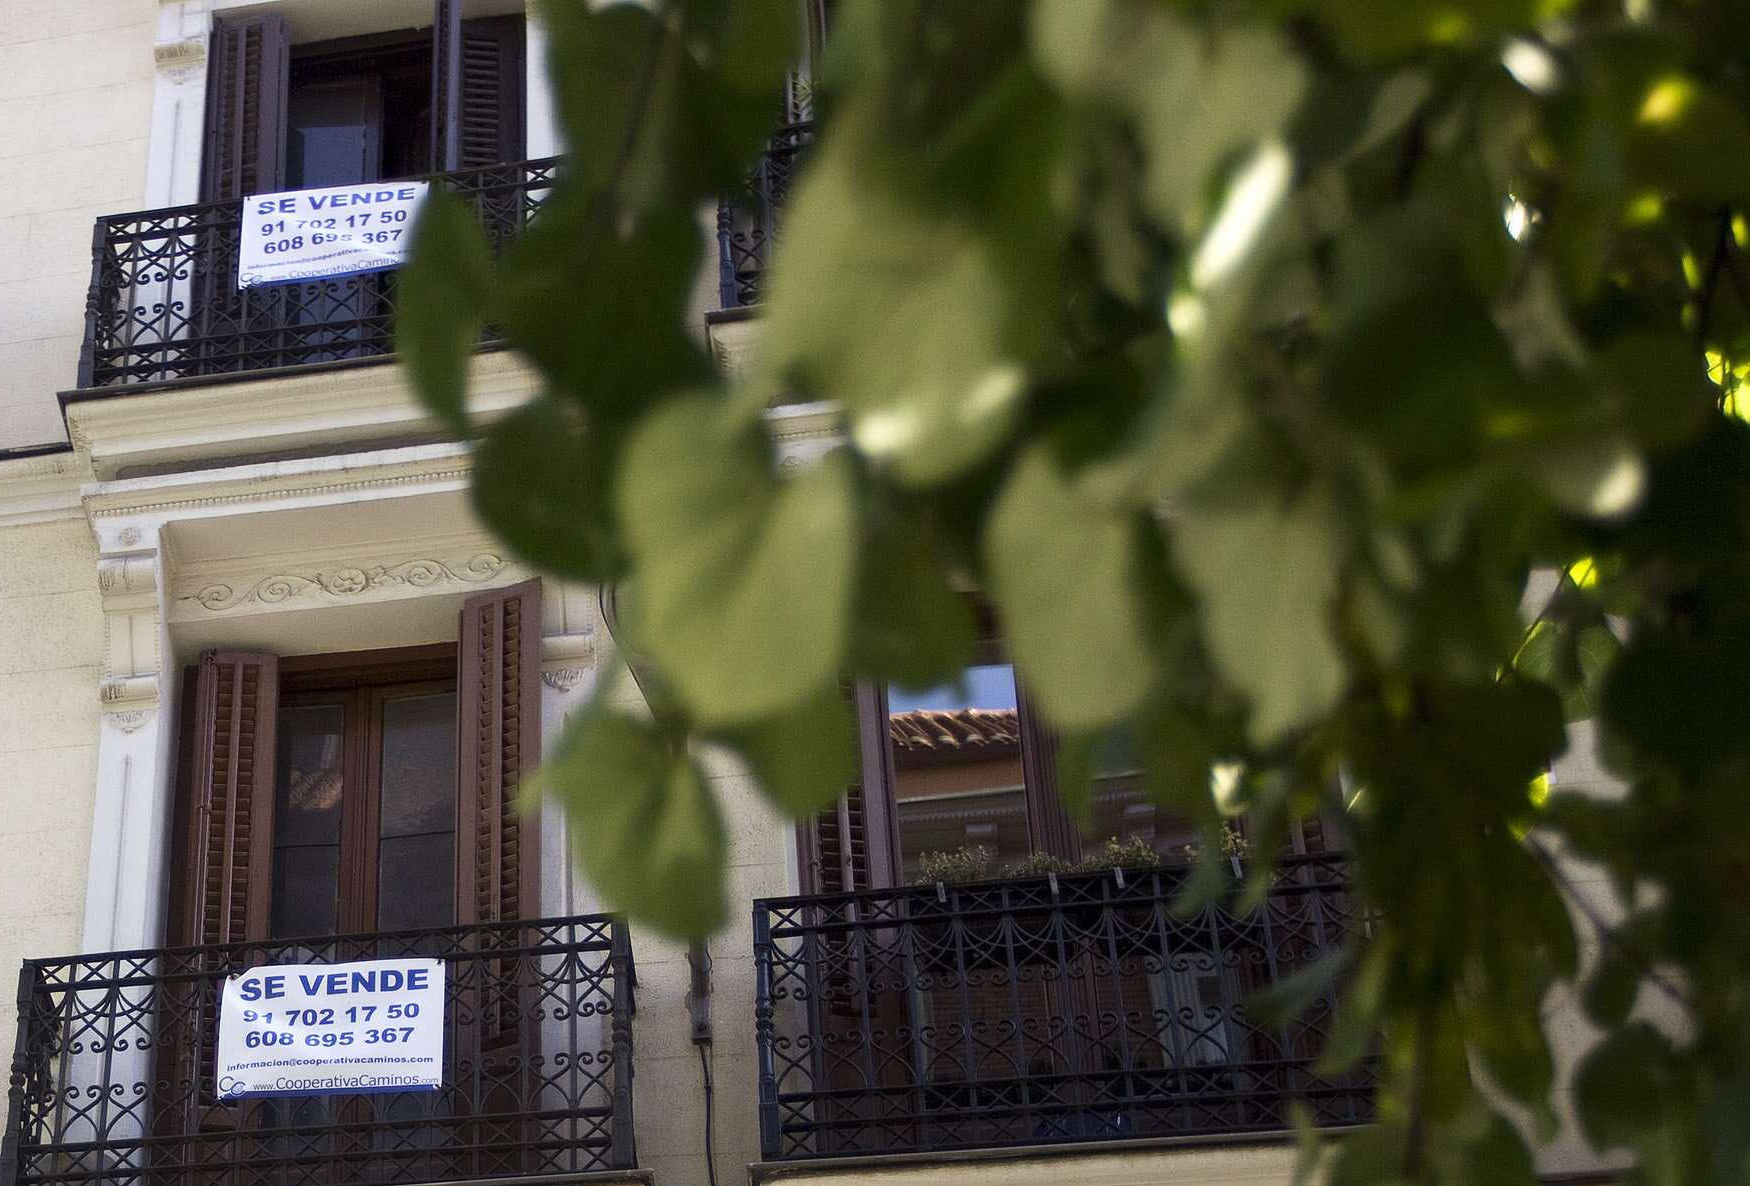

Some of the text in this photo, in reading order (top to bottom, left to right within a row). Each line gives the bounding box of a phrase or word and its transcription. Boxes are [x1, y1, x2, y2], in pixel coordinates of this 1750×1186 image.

[258, 188, 416, 215] SE VENDE
[261, 210, 407, 236] 91 702 17 50
[264, 236, 303, 254] 608
[362, 229, 403, 244] 367
[240, 969, 429, 1001] SE VENDE
[243, 1003, 419, 1026] 91 702 17 50
[245, 1027, 415, 1048] 608 695 367
[227, 1056, 433, 1072] informacion@cooperativacaminos.com
